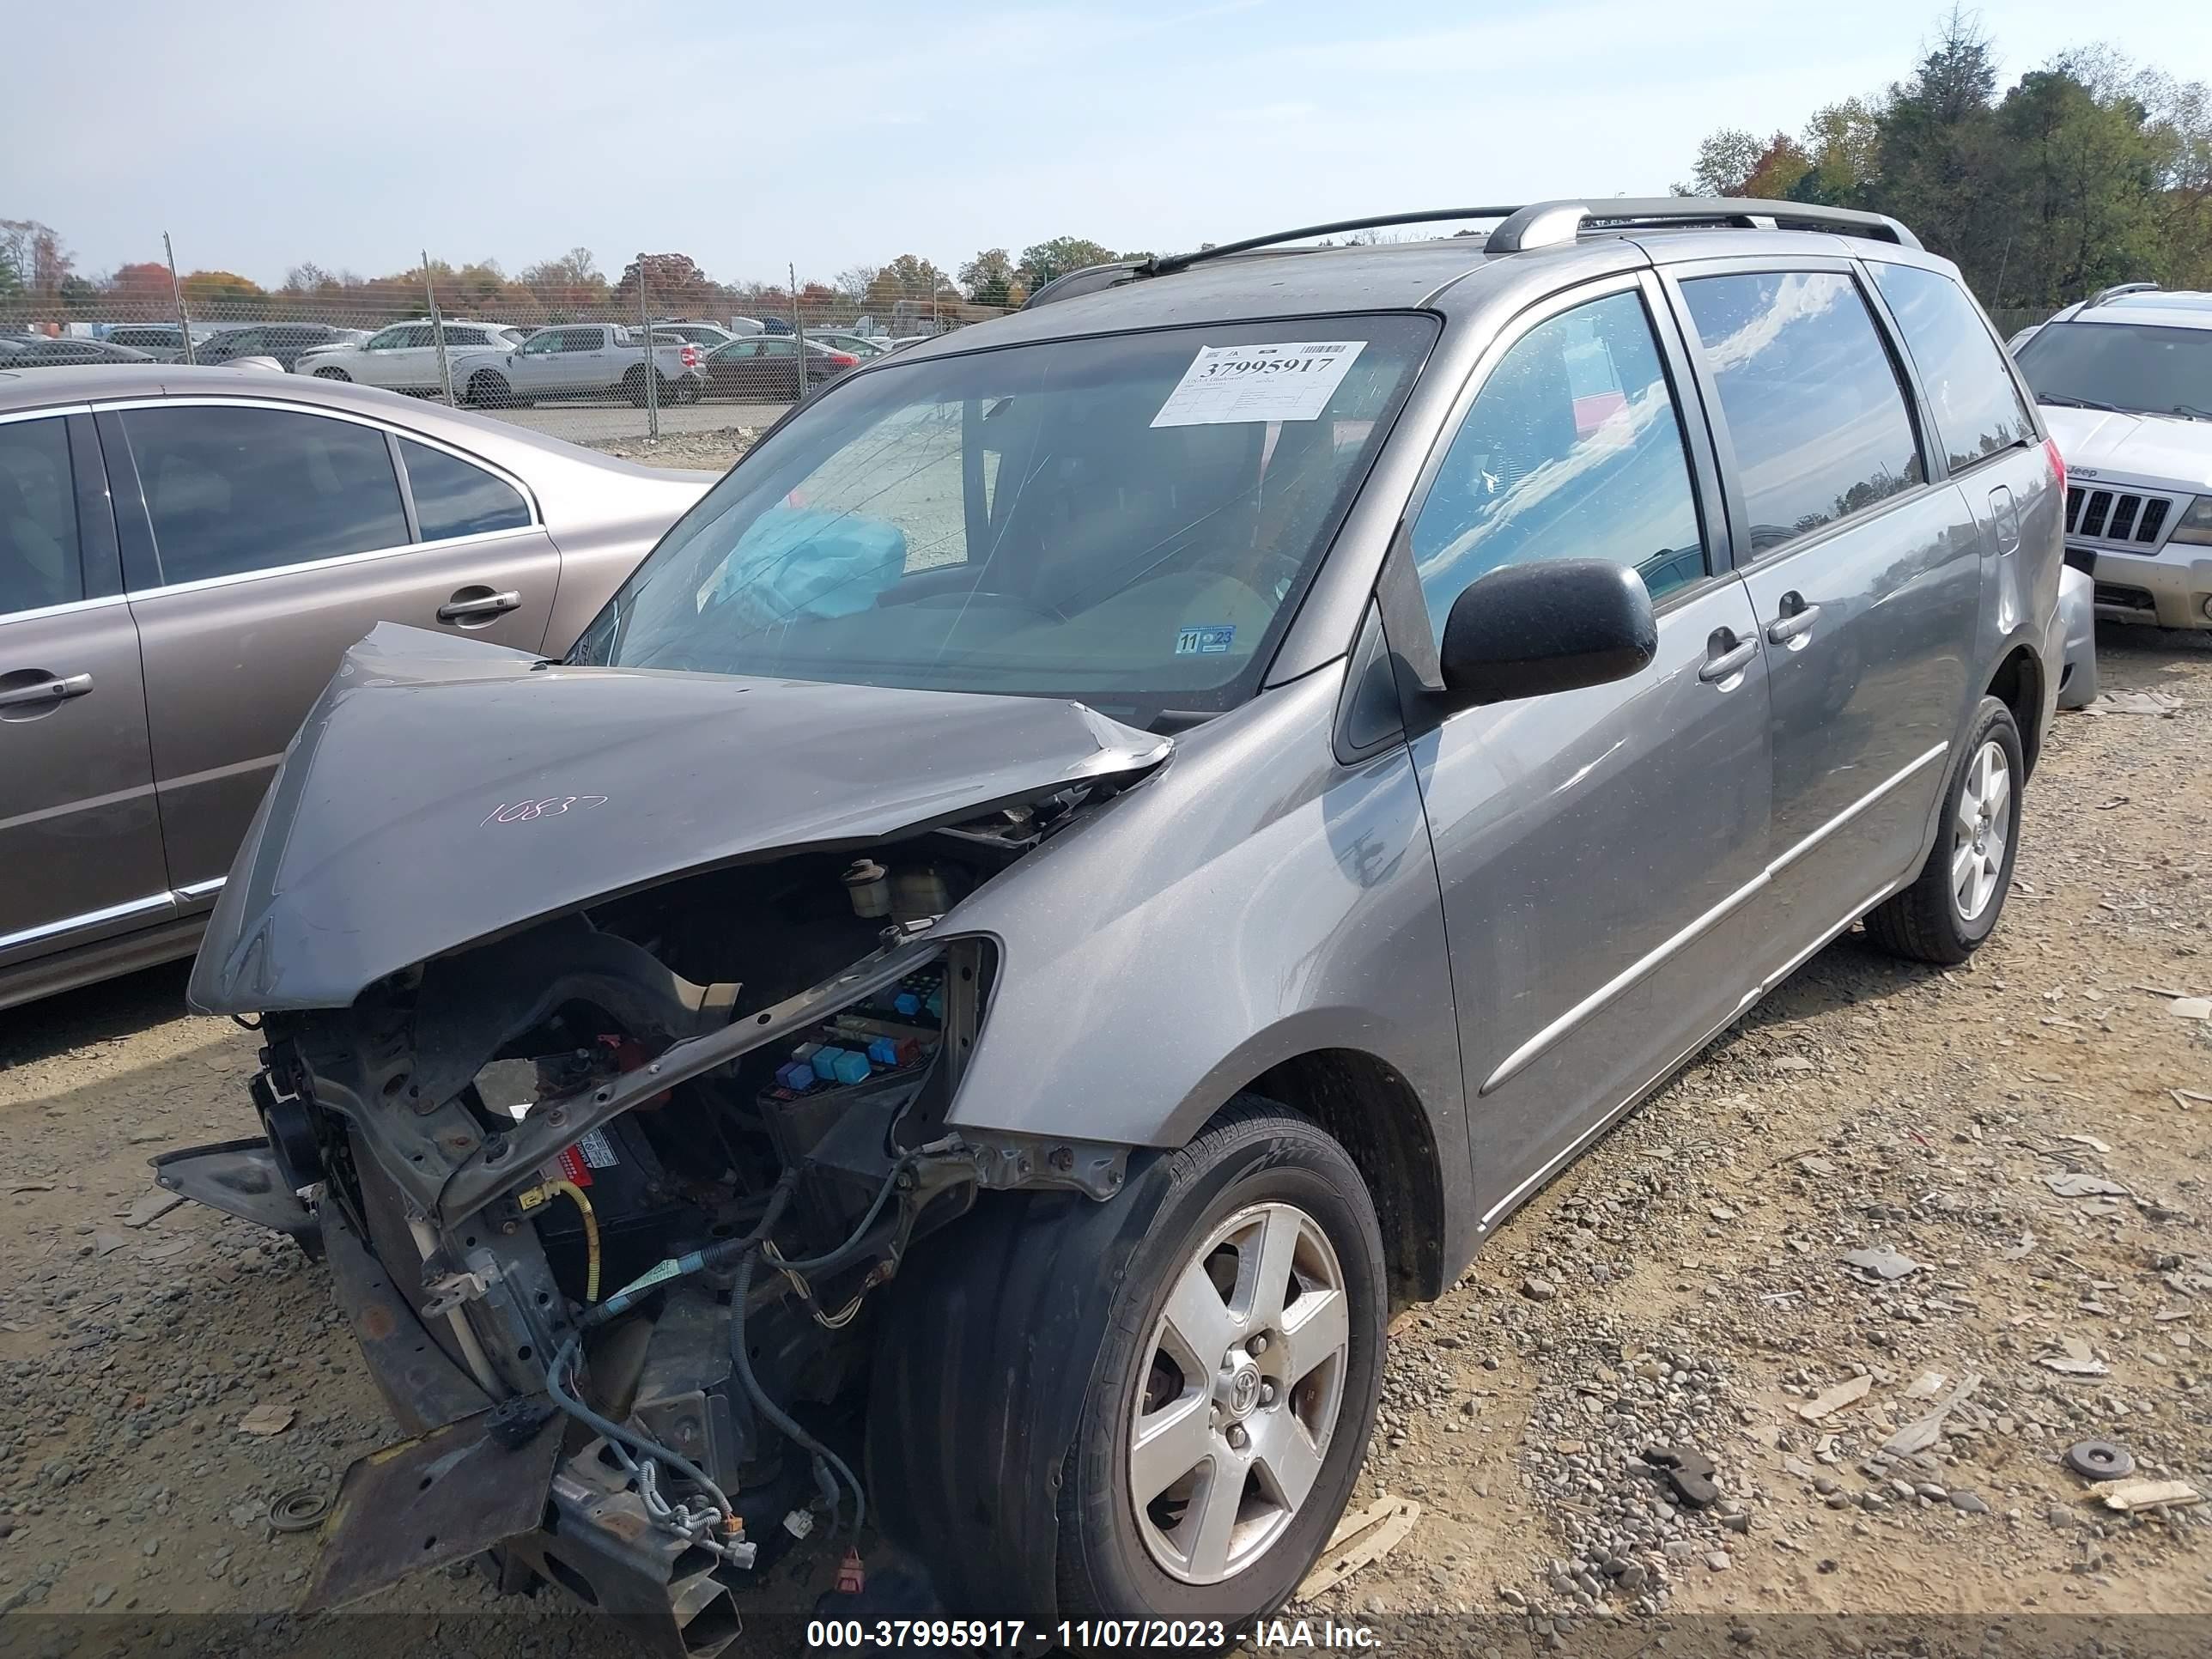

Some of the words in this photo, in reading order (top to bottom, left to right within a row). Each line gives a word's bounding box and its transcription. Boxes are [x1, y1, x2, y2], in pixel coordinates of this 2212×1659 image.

[1200, 357, 1334, 378] 37995917
[2067, 465, 2098, 478] Jeep
[1181, 633, 1198, 651] 11
[1214, 631, 1232, 644] 23
[479, 795, 609, 828] 10837
